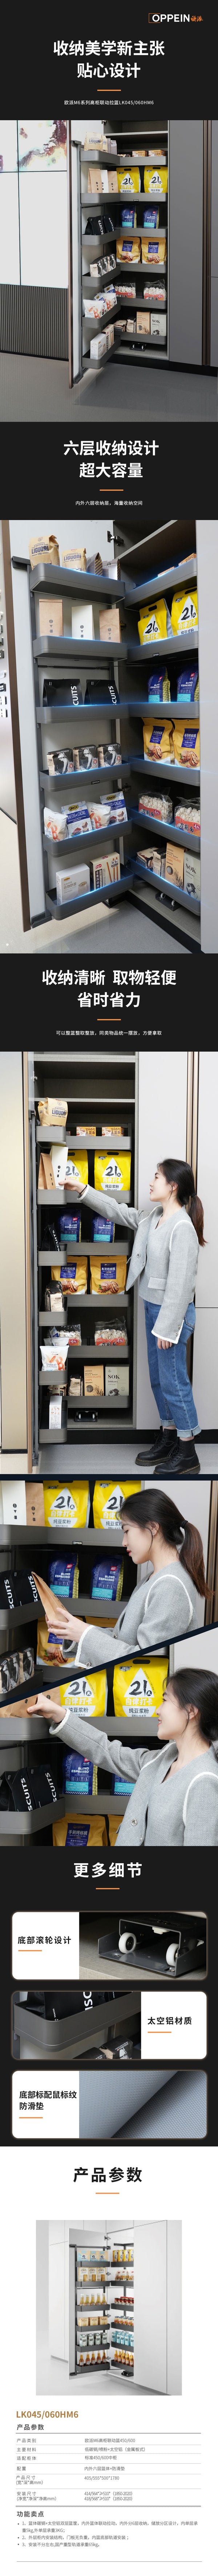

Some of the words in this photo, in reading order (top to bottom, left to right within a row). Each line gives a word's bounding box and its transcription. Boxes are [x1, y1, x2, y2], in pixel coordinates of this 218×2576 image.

[32, 546, 49, 554] LIGUORI
[142, 809, 154, 817] 刀削面
[180, 823, 194, 832] 刀削面
[166, 855, 181, 863] CHOCOLATE
[186, 863, 197, 874] SOK
[65, 1697, 92, 1706] 自律打卡
[125, 1697, 153, 1706] 自律打卡
